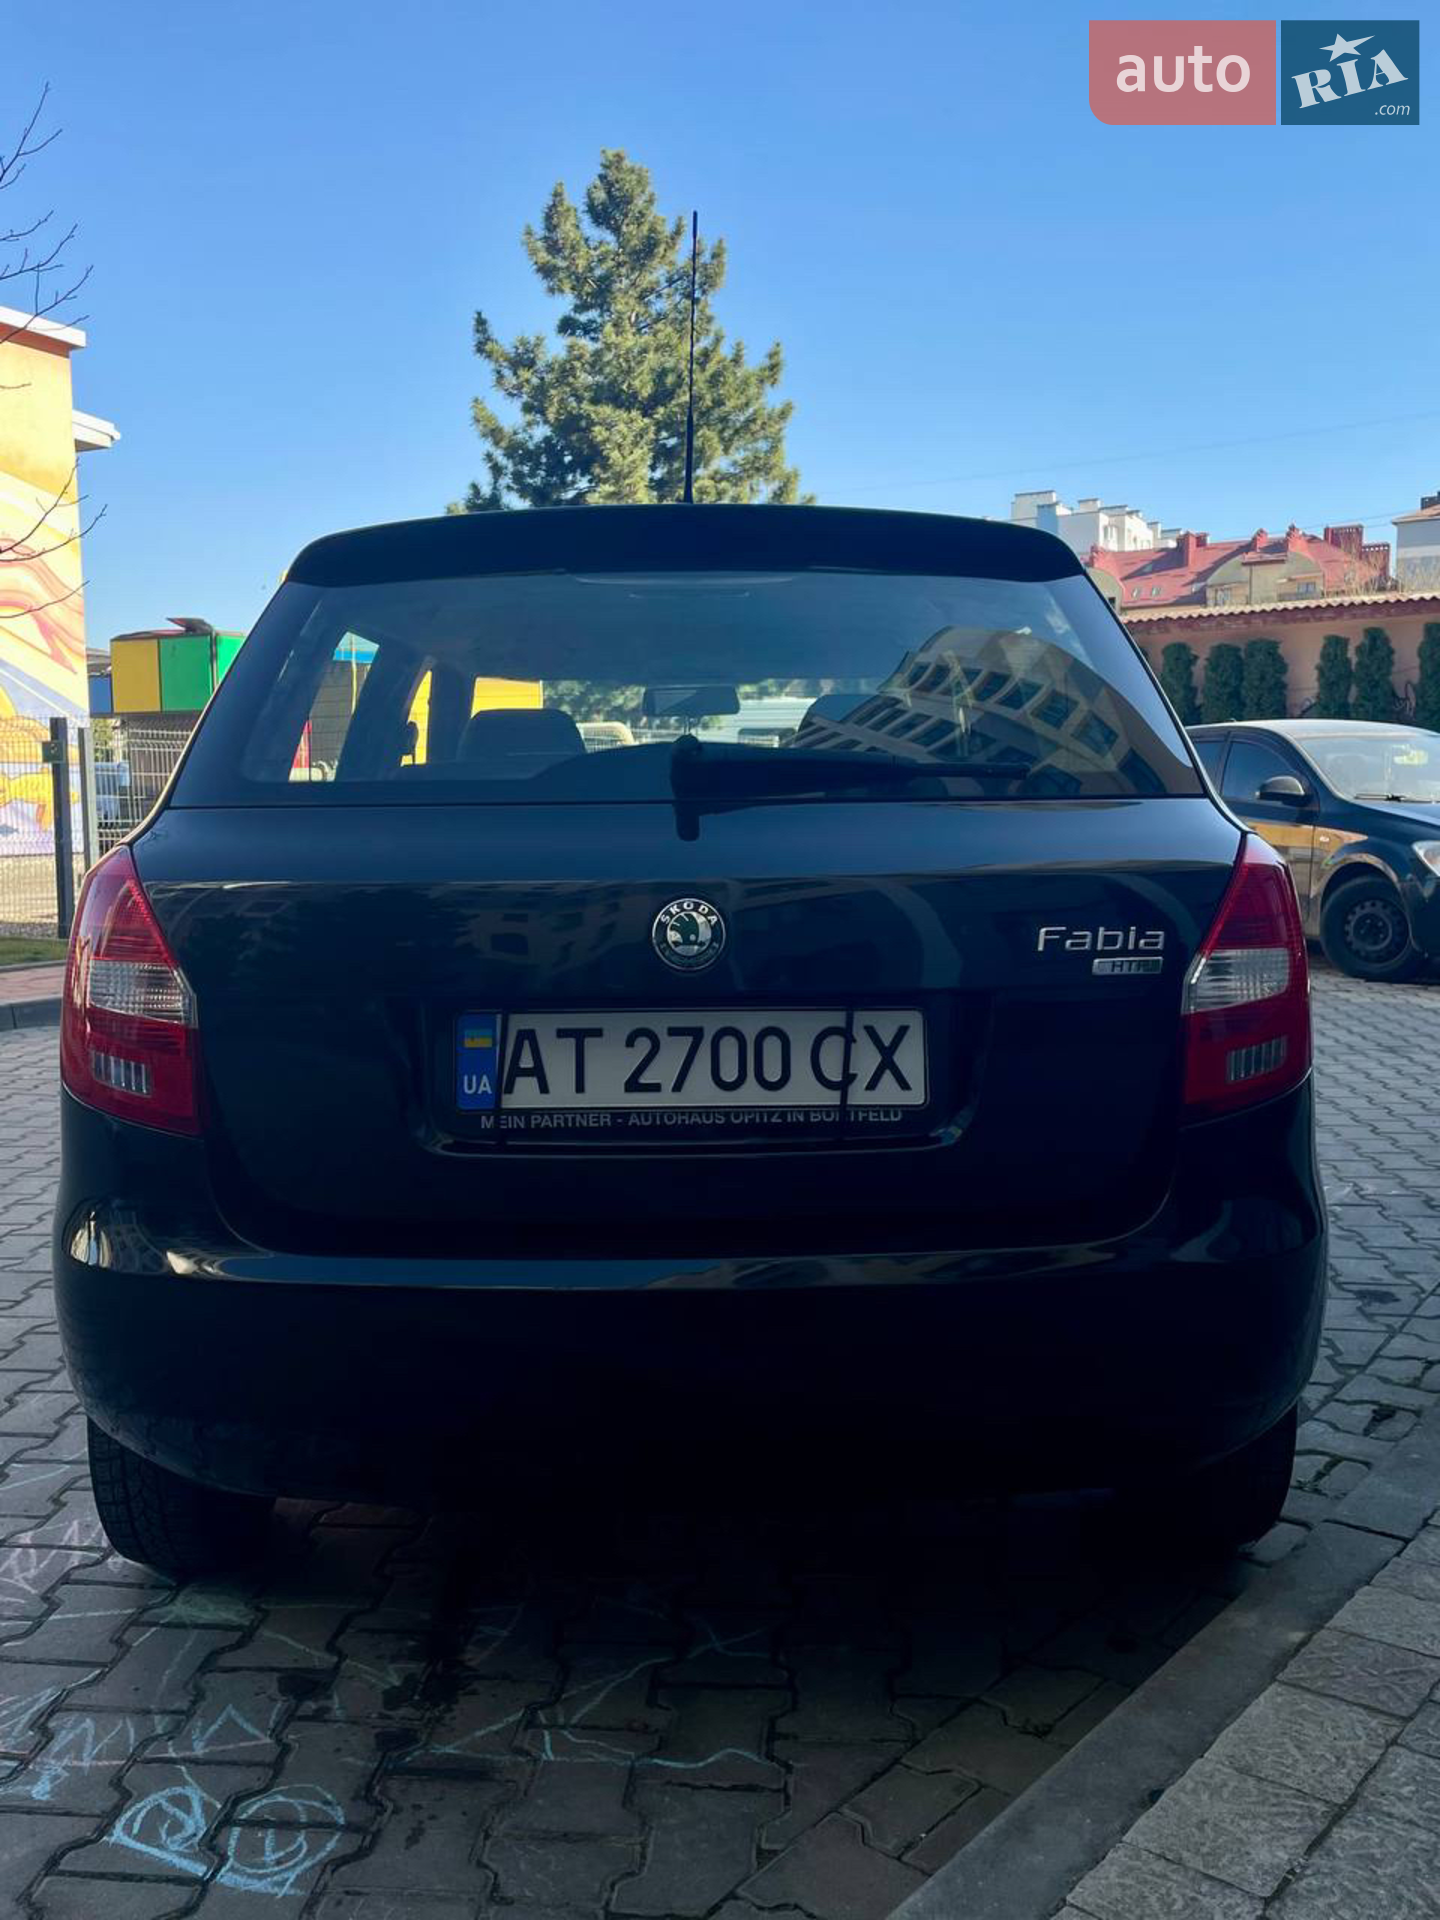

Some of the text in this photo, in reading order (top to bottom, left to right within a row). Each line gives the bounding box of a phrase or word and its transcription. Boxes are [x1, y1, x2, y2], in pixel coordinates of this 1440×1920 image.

[1037, 926, 1165, 951] Fabia
[503, 1025, 913, 1094] AT 2700 CX
[462, 1074, 493, 1095] UA
[480, 1115, 526, 1129] MEIN
[530, 1113, 612, 1129] PARTNER
[628, 1111, 726, 1126] AUTOHAUS
[787, 1109, 804, 1123] IN
